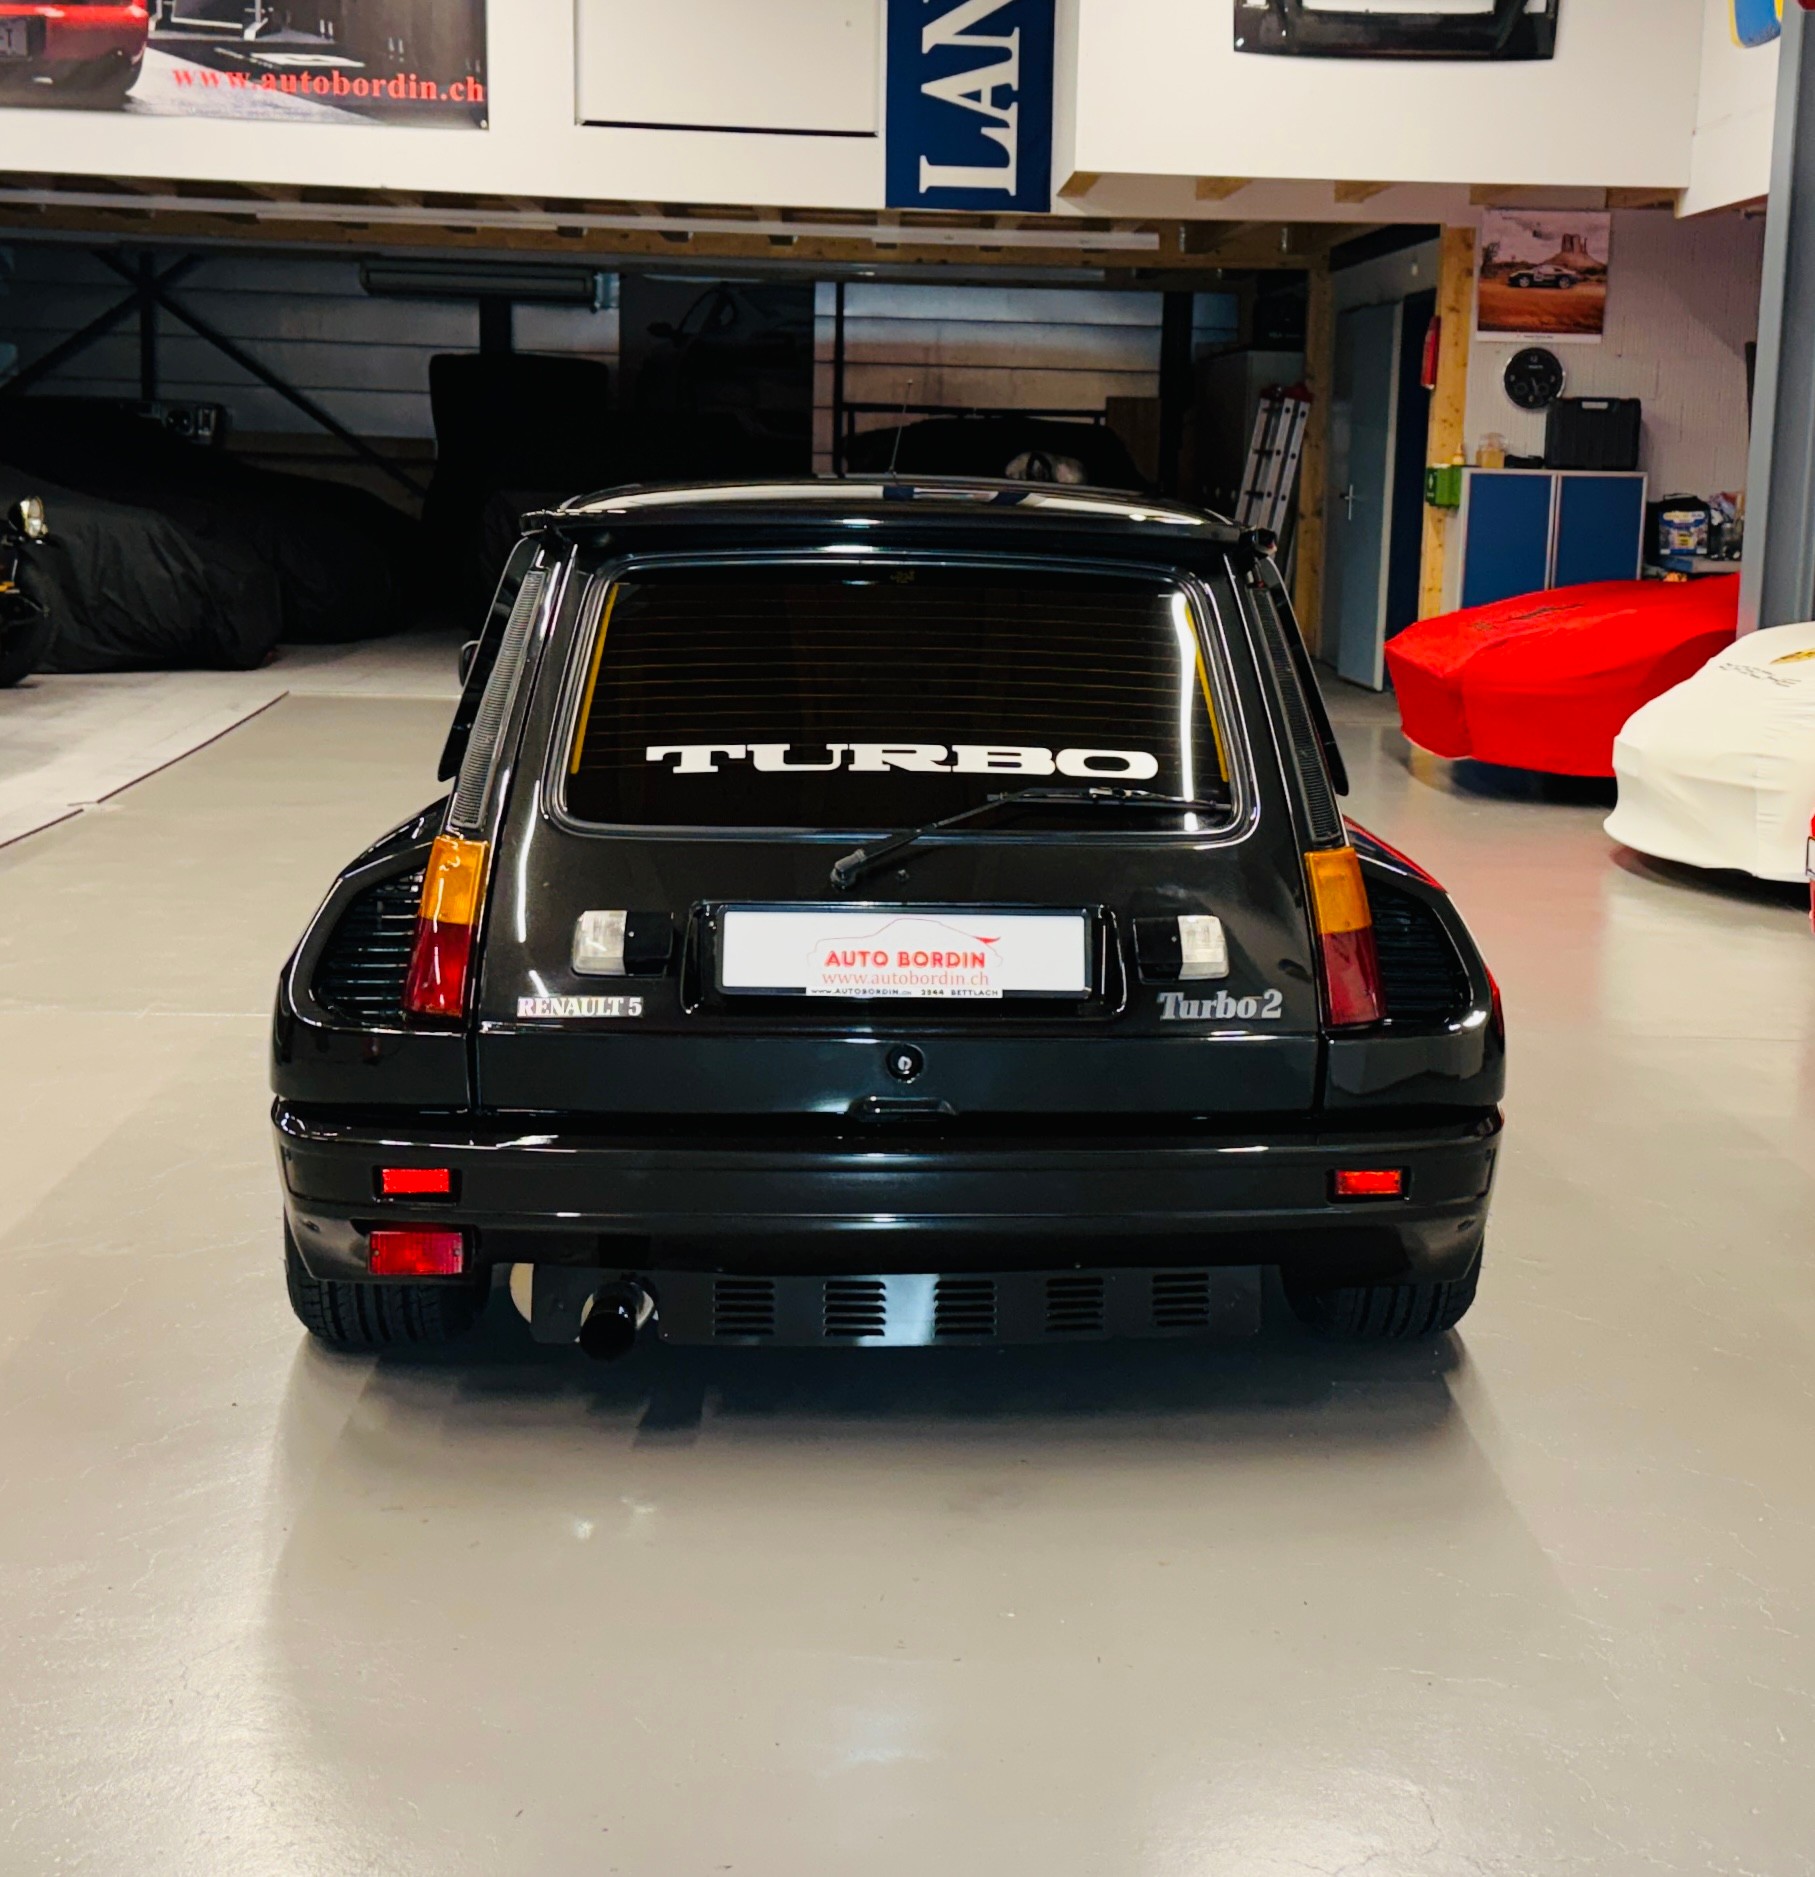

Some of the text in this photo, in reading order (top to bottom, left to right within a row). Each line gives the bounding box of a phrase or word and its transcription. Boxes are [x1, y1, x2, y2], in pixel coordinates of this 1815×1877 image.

[172, 69, 485, 102] www.autobordin.ch
[646, 743, 1158, 779] TURBO
[824, 951, 985, 969] AUTO BORDIN
[822, 970, 989, 986] www.autobordin.ch
[950, 989, 999, 997] BETTLACH
[1156, 988, 1283, 1019] Turbo 2
[517, 996, 643, 1018] RENAULT 5
